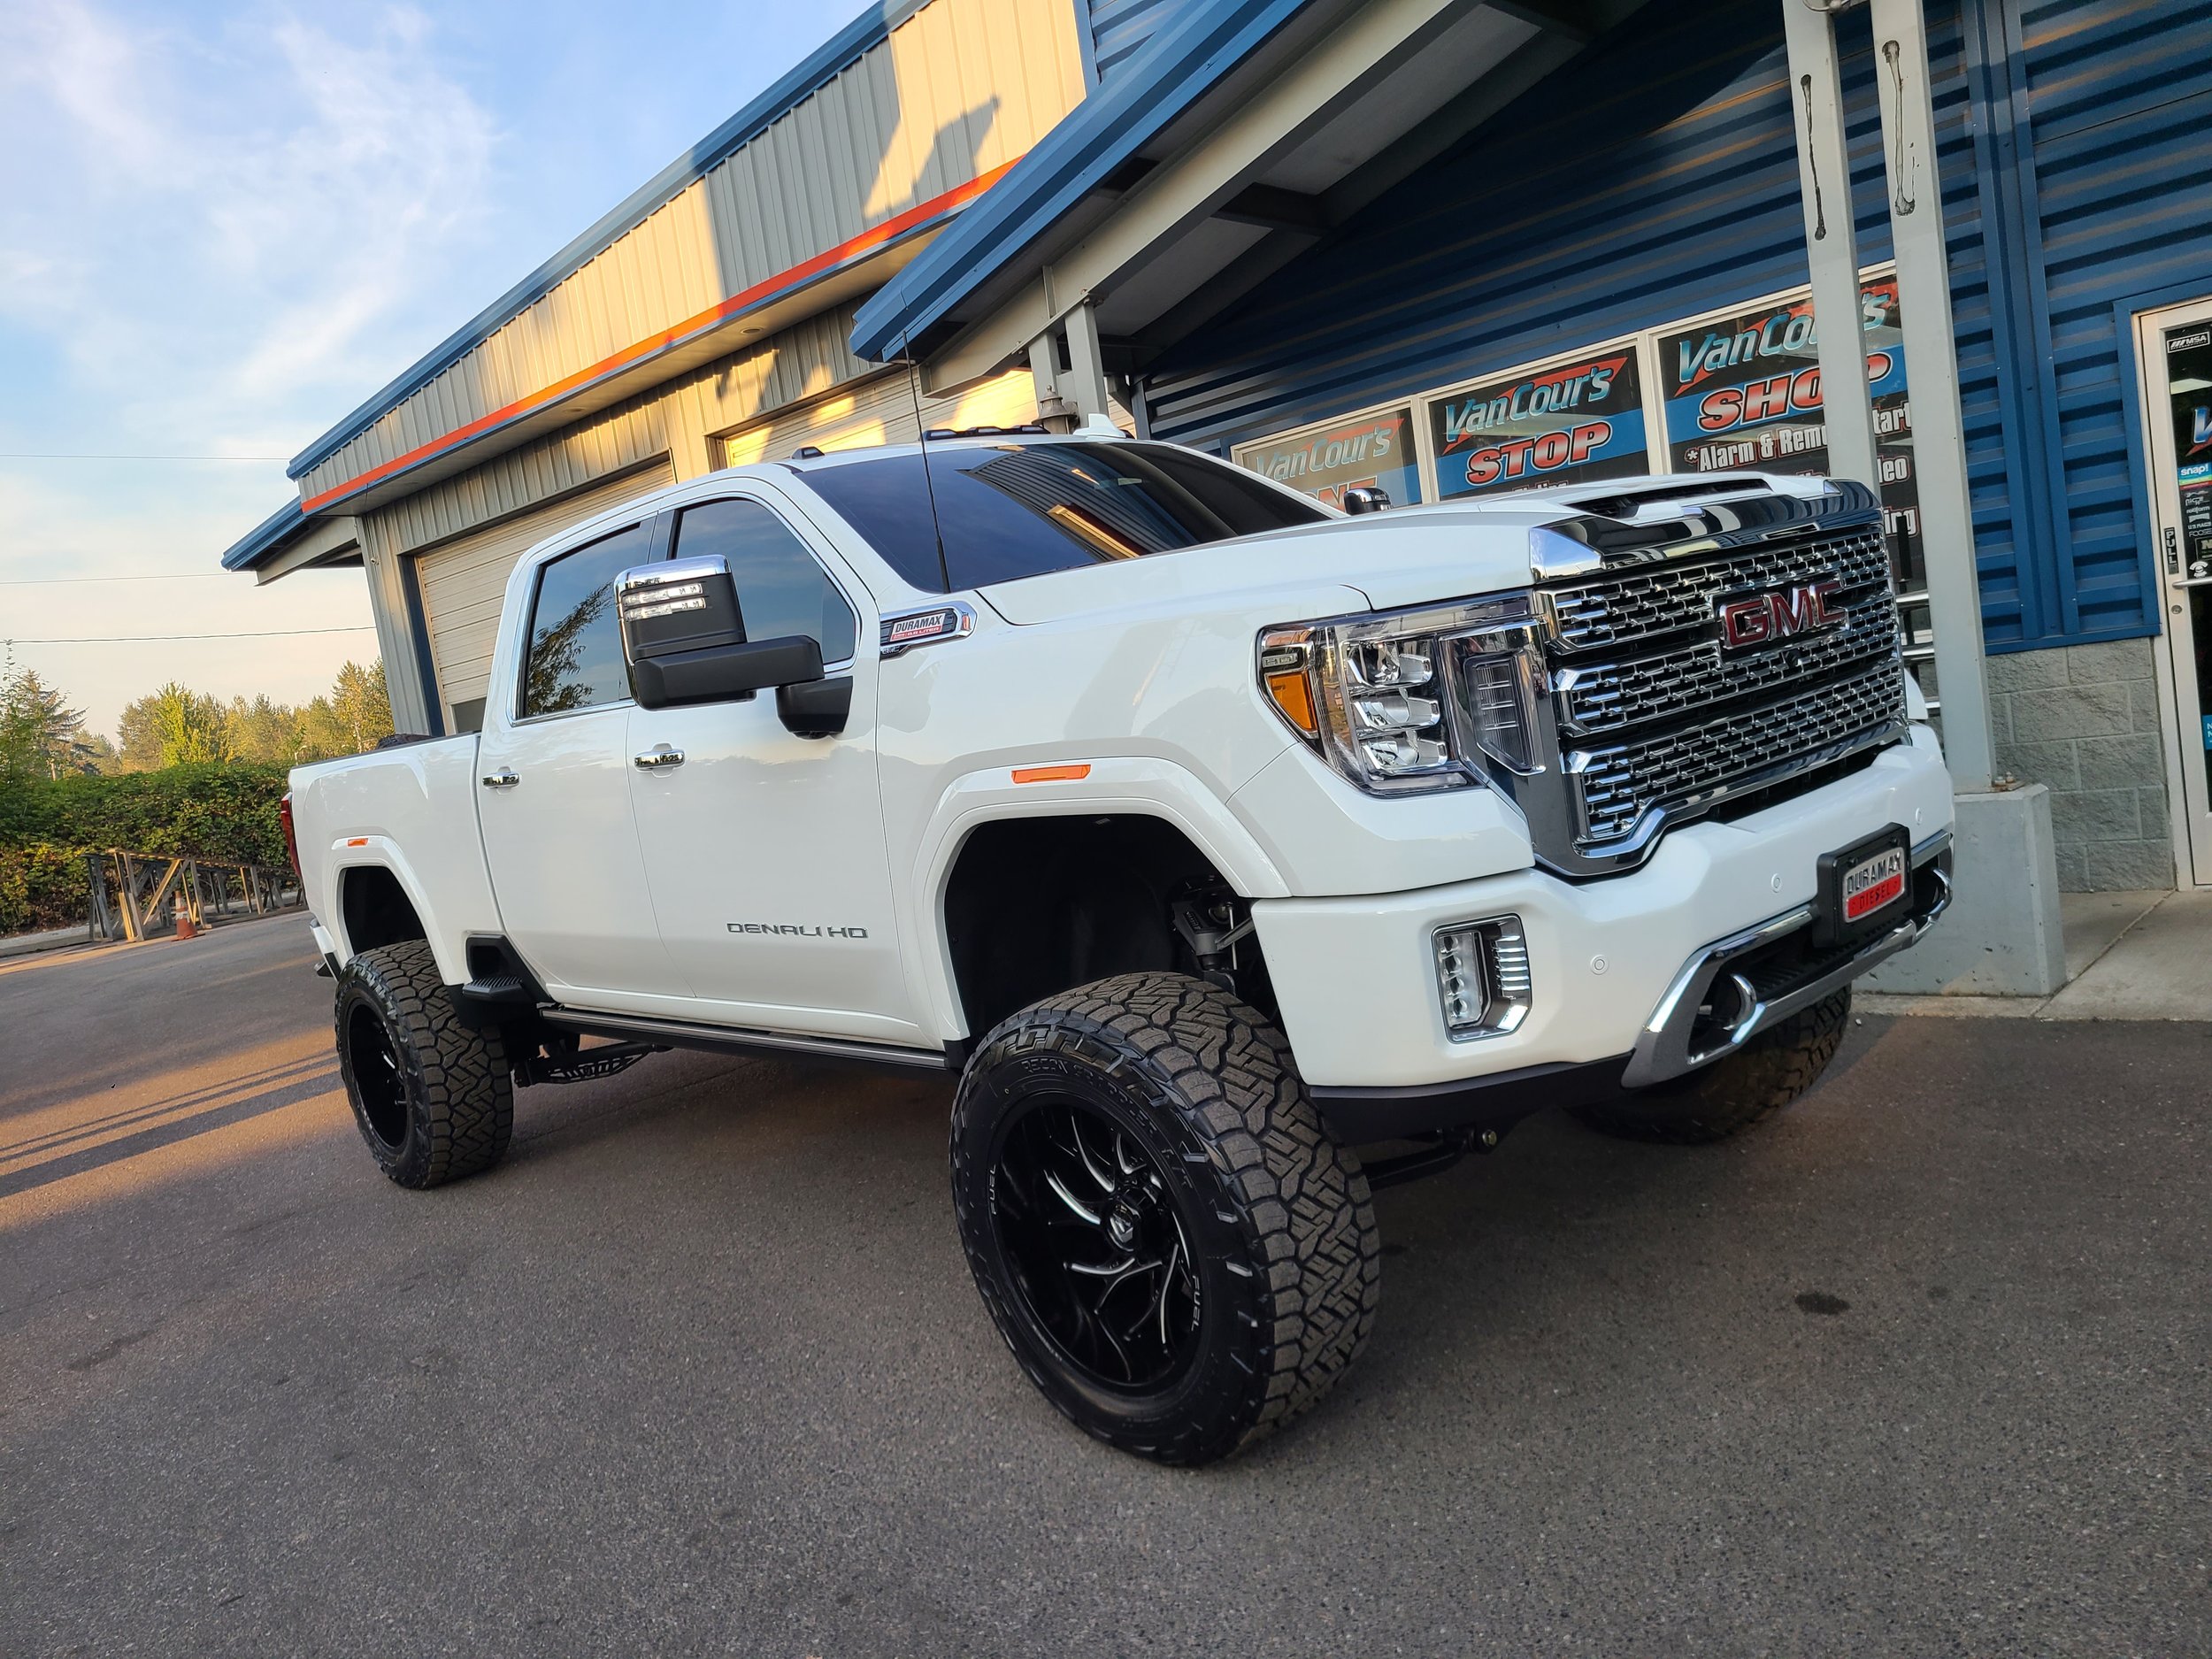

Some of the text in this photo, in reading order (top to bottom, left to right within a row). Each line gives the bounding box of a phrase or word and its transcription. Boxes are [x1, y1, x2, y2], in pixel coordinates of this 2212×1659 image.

[1679, 292, 1890, 383] VanCo's
[2186, 335, 2207, 345] MSA
[1446, 366, 1613, 442] VanCour's
[1256, 426, 1392, 481] VanCour's
[1465, 421, 1612, 486] STOP
[1760, 434, 1773, 457] &
[1780, 426, 1827, 454] Rem
[1871, 403, 1912, 434] tart
[2180, 464, 2209, 476] snap!
[2165, 531, 2177, 564] PULL
[895, 615, 942, 633] DURAMAX
[1721, 580, 1847, 649] GMC
[1847, 851, 1901, 894] DURAMAX
[1859, 883, 1891, 910] DIESEL
[726, 923, 869, 938] DENALI HD
[1191, 1274, 1201, 1332] FUEL
